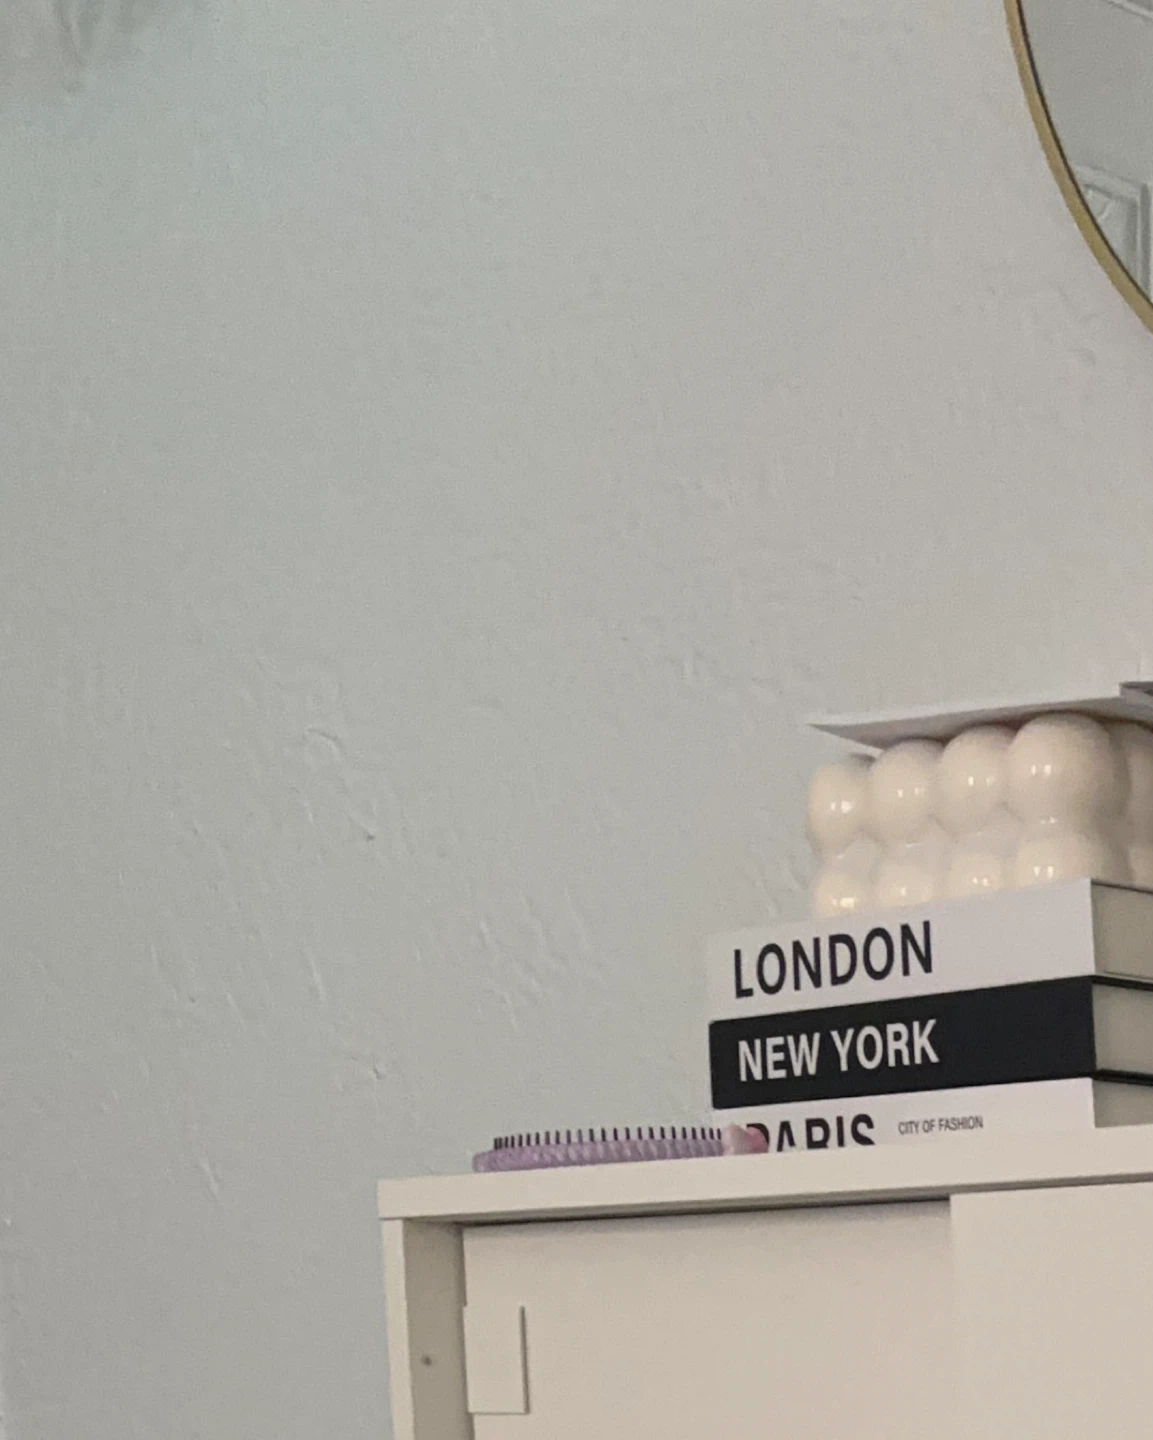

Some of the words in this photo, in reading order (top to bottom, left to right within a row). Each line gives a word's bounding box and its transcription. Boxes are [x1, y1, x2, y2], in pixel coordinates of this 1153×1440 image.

[733, 920, 934, 999] LONDON
[738, 1032, 821, 1082] NEW
[830, 1018, 940, 1072] YORK
[898, 1120, 921, 1135] CITY
[923, 1119, 936, 1133] OF
[938, 1115, 984, 1132] FASHION
